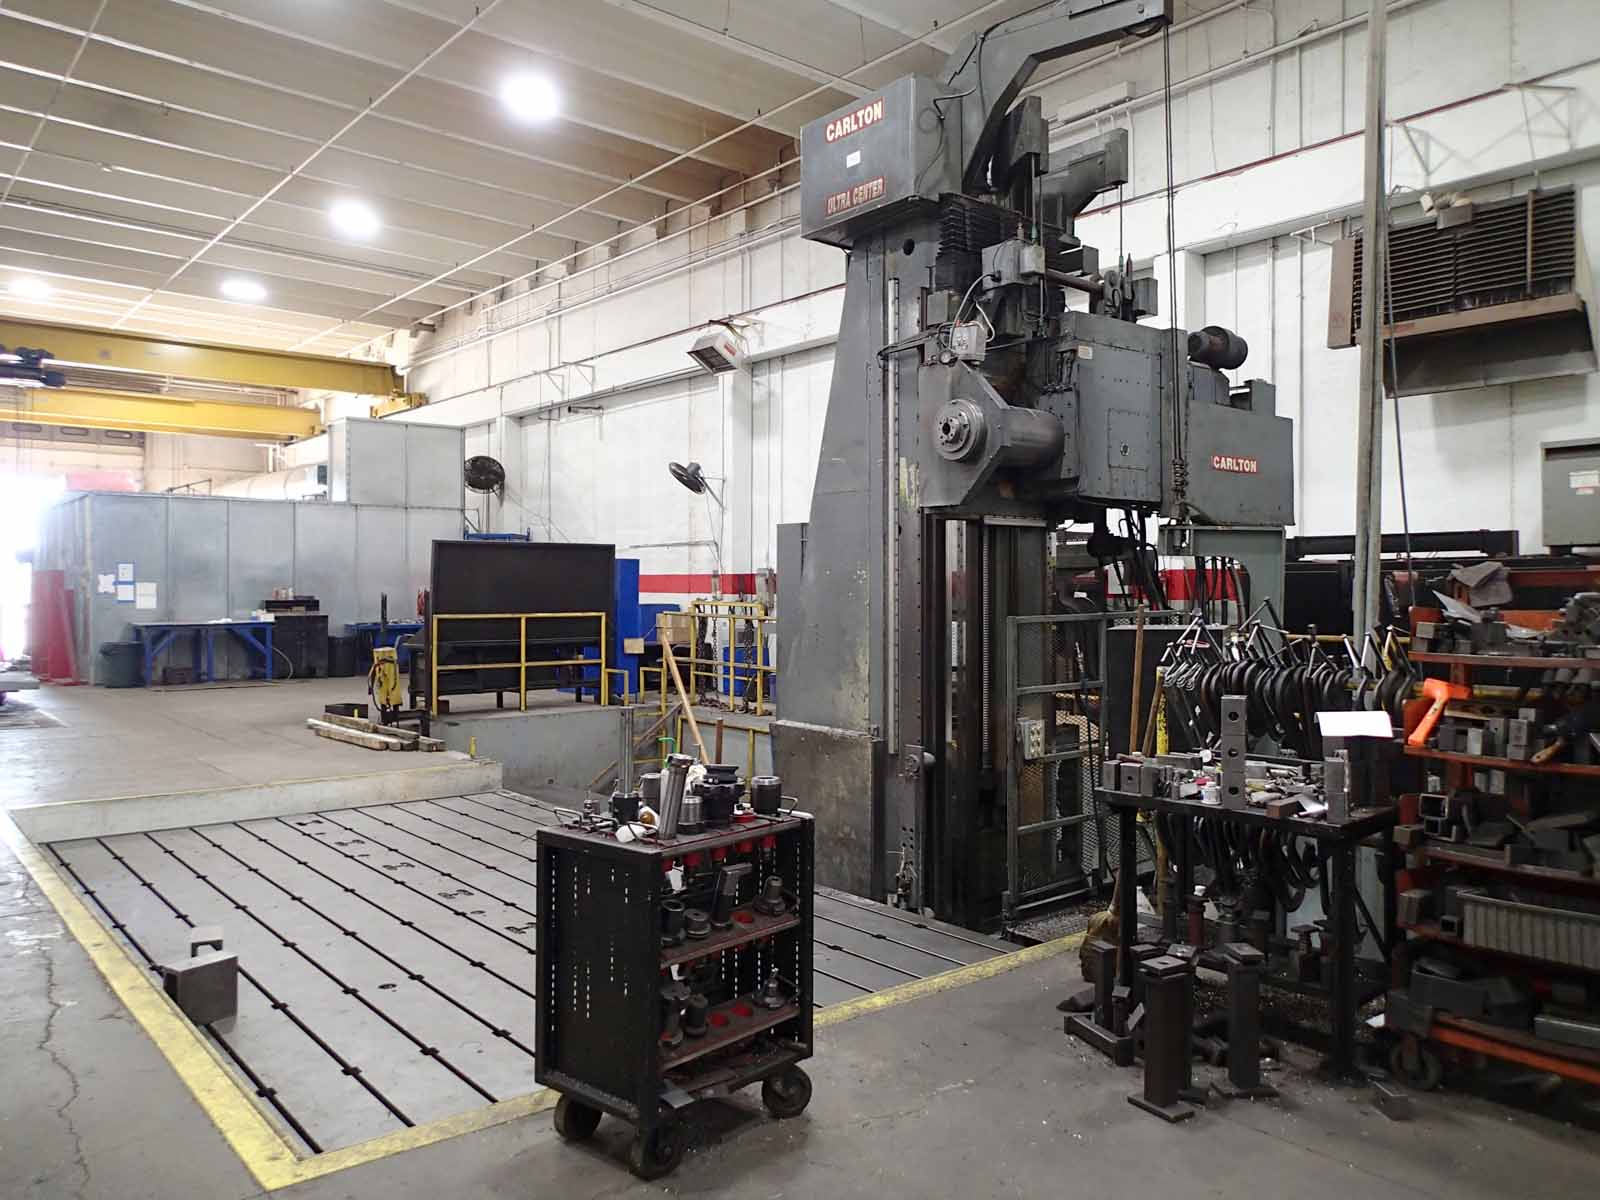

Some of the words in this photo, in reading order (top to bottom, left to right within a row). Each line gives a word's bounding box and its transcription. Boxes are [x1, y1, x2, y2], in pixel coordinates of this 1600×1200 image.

[826, 101, 882, 142] CARLTON
[827, 191, 850, 214] ULTRA
[852, 178, 883, 205] CENTER
[1213, 456, 1257, 473] CARLTON
